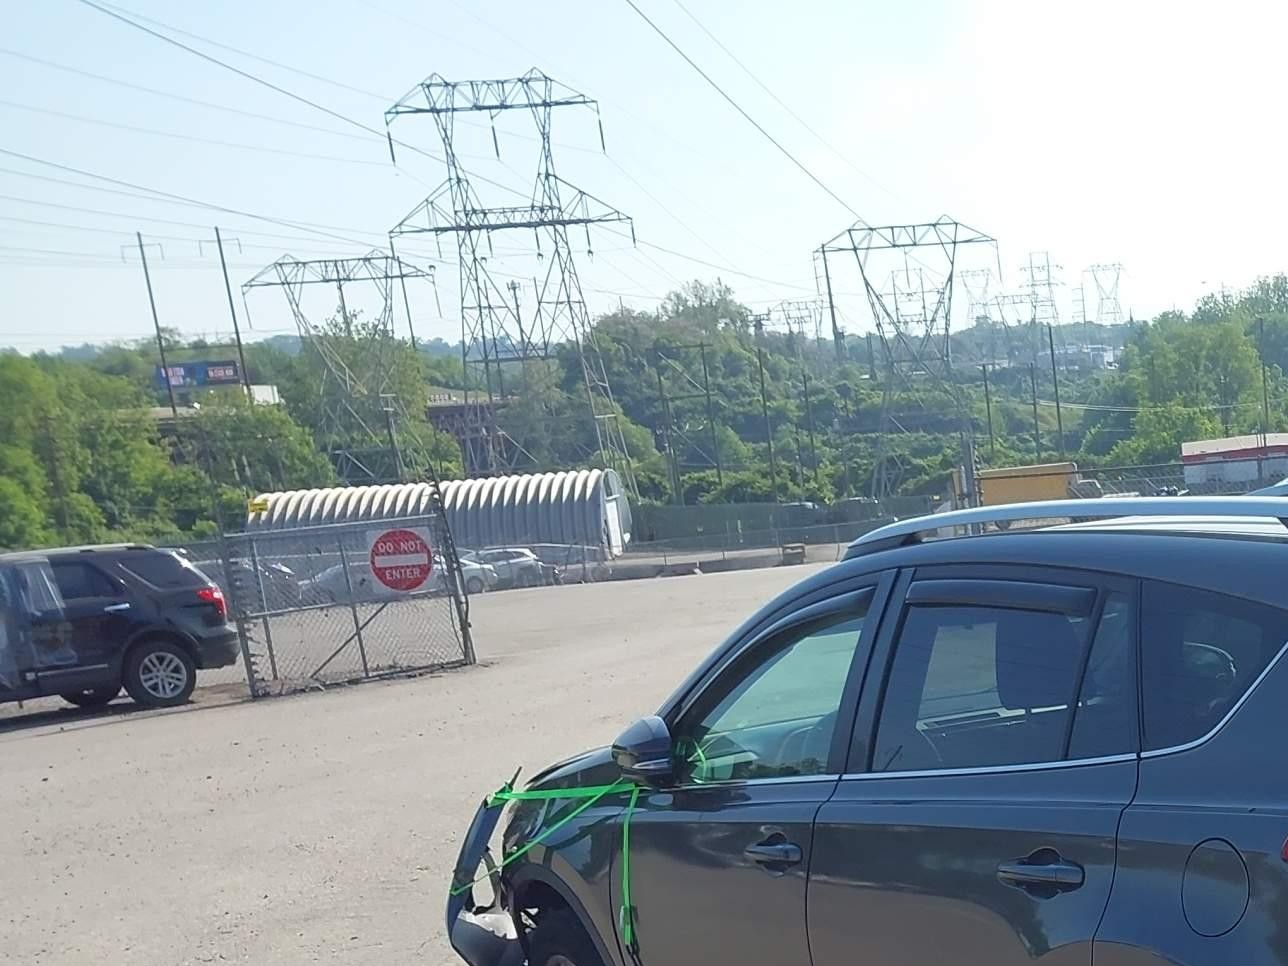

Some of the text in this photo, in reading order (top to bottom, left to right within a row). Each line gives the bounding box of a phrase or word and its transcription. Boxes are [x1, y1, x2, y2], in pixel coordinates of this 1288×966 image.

[378, 540, 421, 553] DO NOT
[385, 568, 421, 580] ENTER
